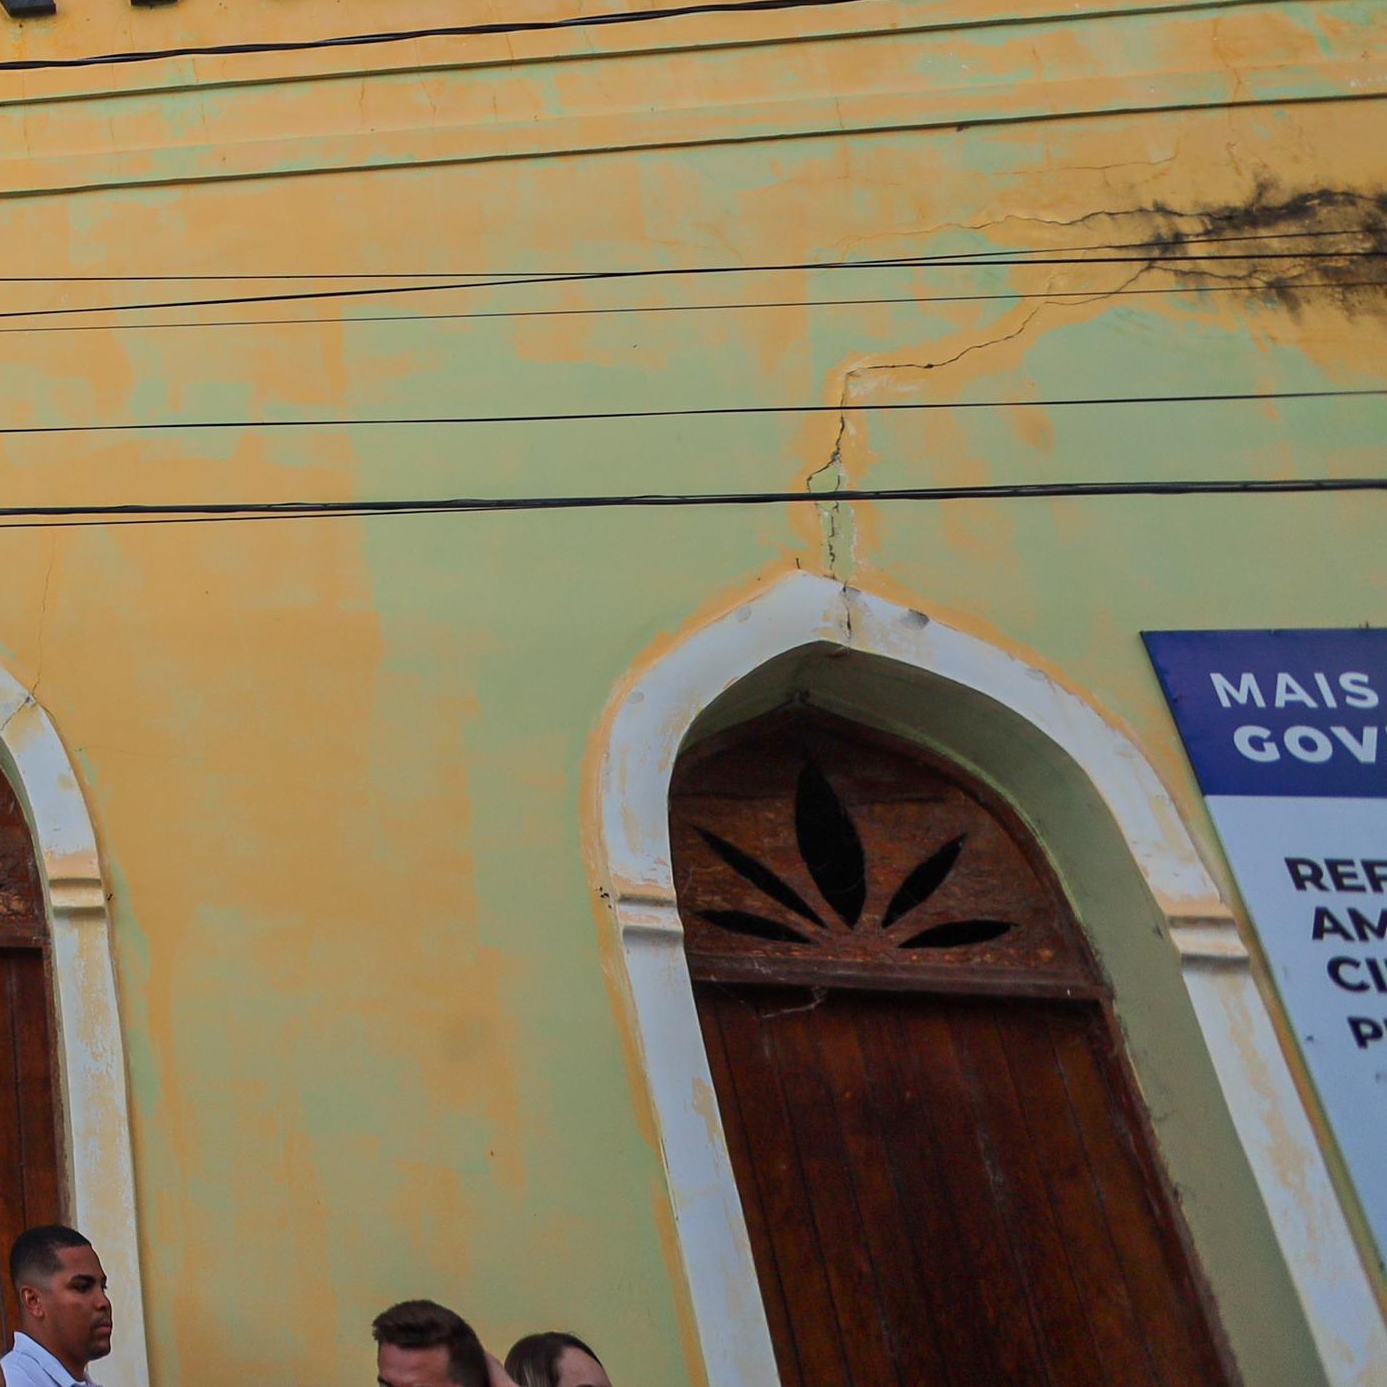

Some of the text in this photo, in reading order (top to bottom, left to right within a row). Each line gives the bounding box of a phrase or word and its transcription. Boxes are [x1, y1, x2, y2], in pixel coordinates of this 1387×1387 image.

[1210, 672, 1379, 709] MAIS
[1233, 725, 1387, 764] GOV
[1327, 956, 1387, 994] CI
